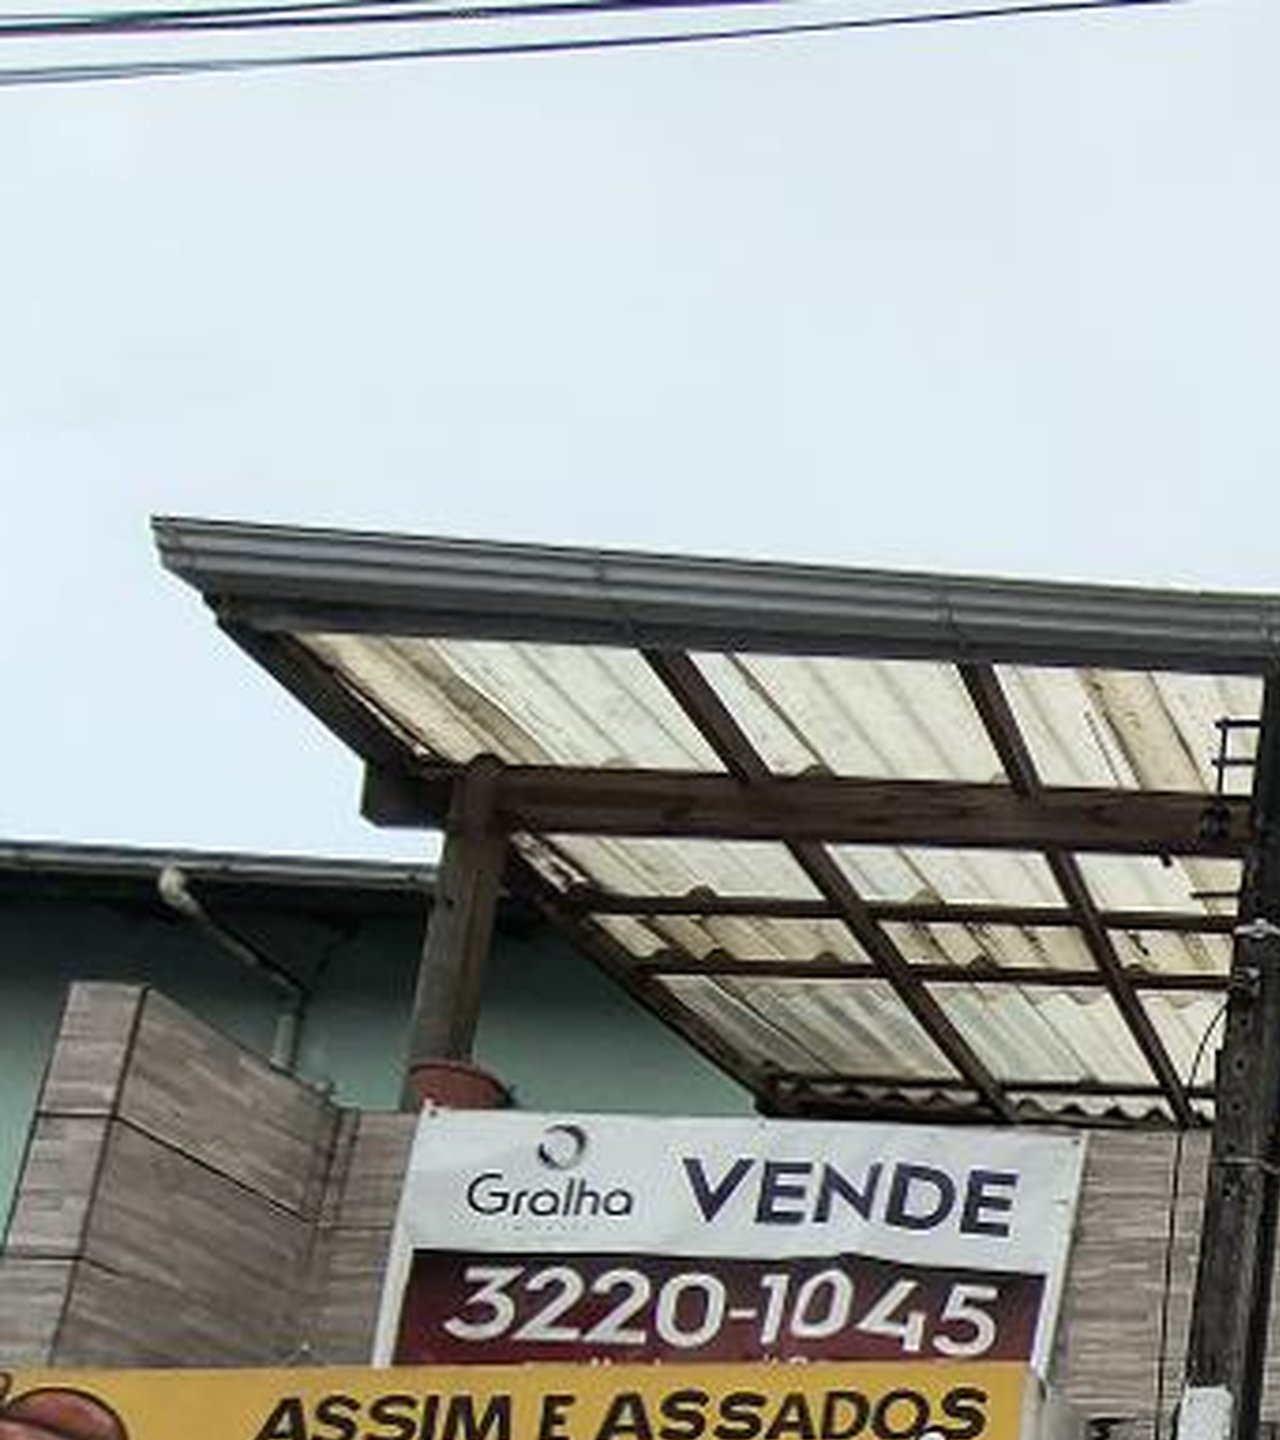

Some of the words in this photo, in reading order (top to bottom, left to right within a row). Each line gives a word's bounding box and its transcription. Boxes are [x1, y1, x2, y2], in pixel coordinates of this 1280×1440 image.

[467, 1172, 633, 1216] Gralha
[683, 1157, 1019, 1237] VENDE
[444, 1266, 998, 1356] 3220-1045
